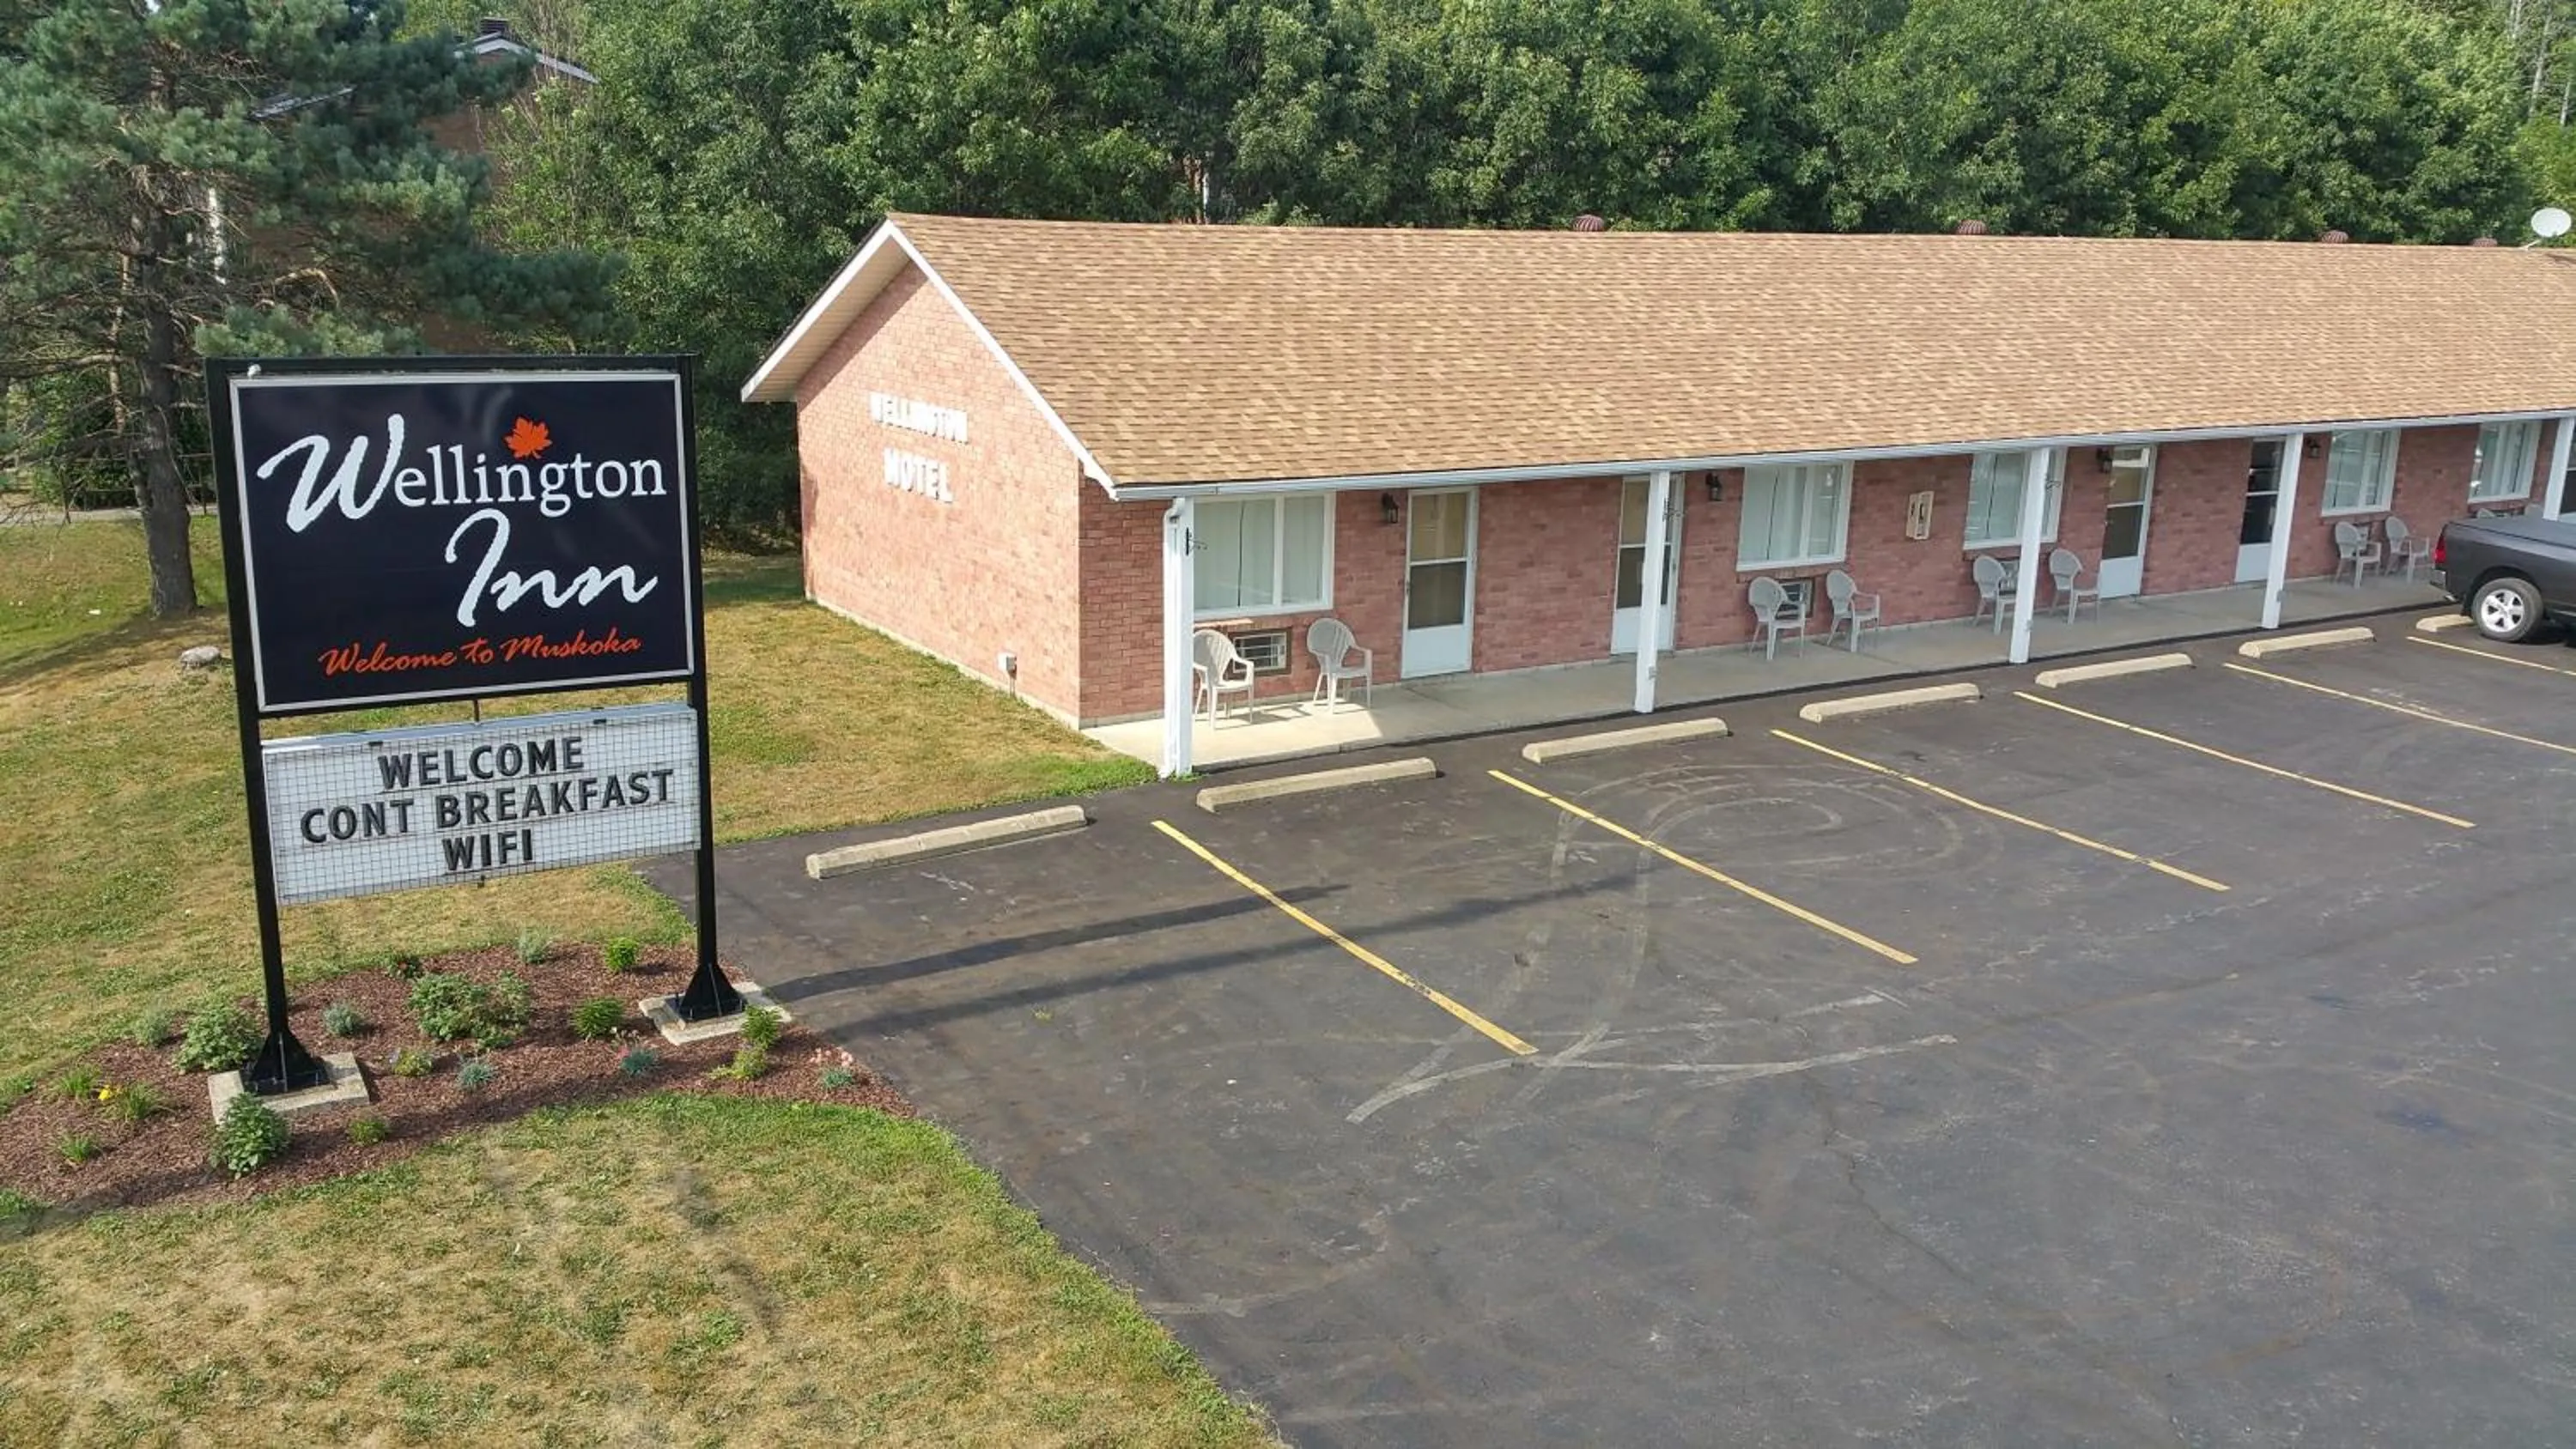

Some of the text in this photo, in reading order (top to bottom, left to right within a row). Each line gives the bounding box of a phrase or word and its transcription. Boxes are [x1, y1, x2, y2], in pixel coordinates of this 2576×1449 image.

[257, 413, 666, 533] Wellington
[884, 446, 954, 504] MOTEL
[445, 508, 659, 628] Inn
[318, 627, 642, 677] Welcome to Muskoka
[378, 736, 585, 791] WELCOME
[300, 768, 675, 845] CONT BREAKFAST
[441, 828, 536, 872] WIFI
